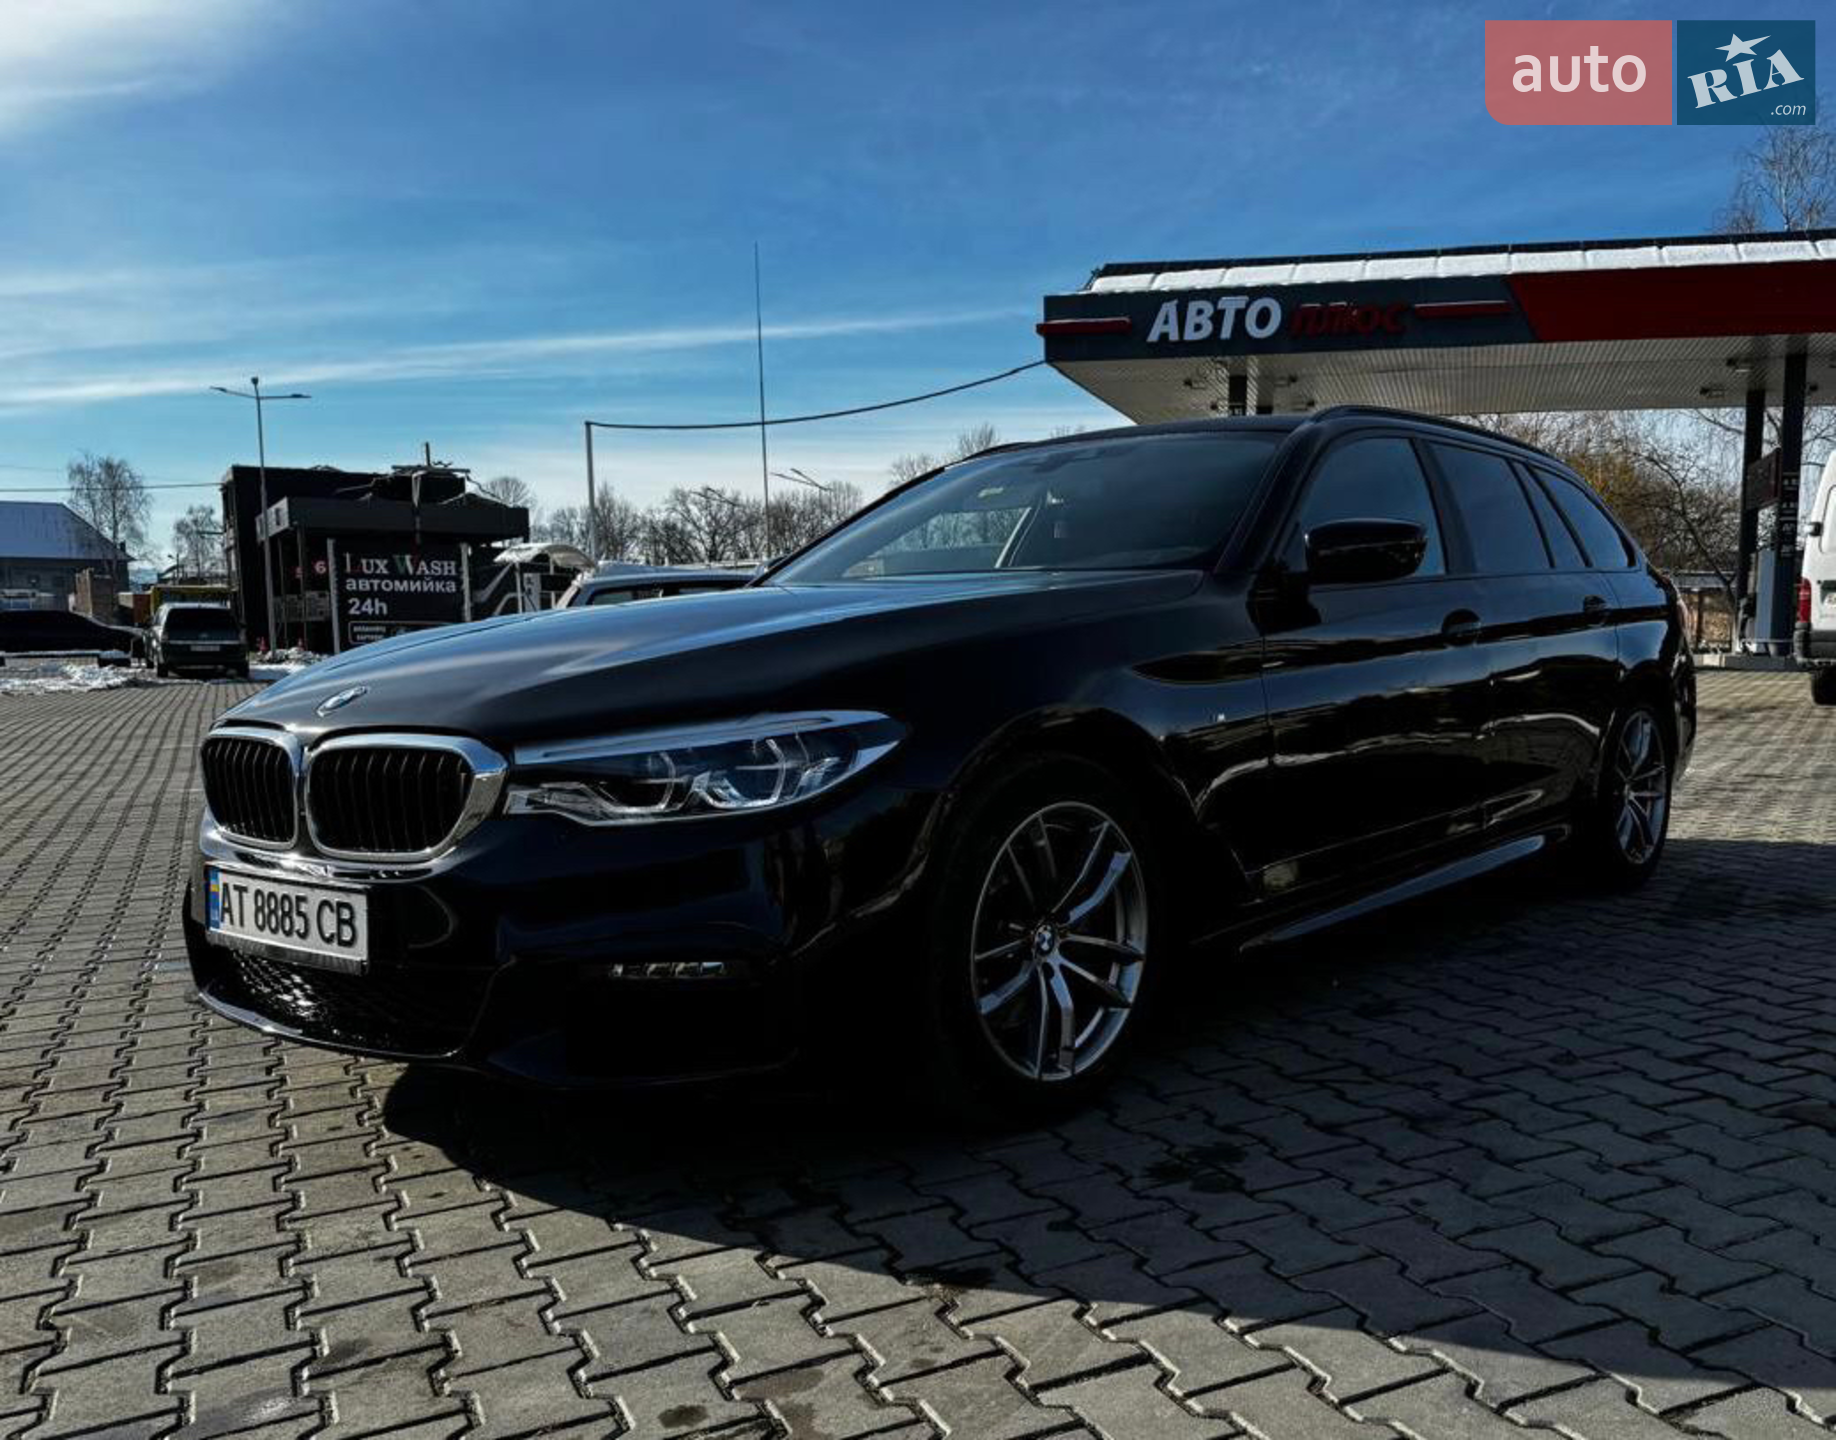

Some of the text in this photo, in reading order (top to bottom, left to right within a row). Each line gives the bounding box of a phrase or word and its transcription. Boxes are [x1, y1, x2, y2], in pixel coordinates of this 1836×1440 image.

[1146, 296, 1282, 342] АВТО
[346, 577, 457, 593] автомийка
[348, 598, 388, 616] 24h
[221, 882, 357, 948] AT 8885 CB
